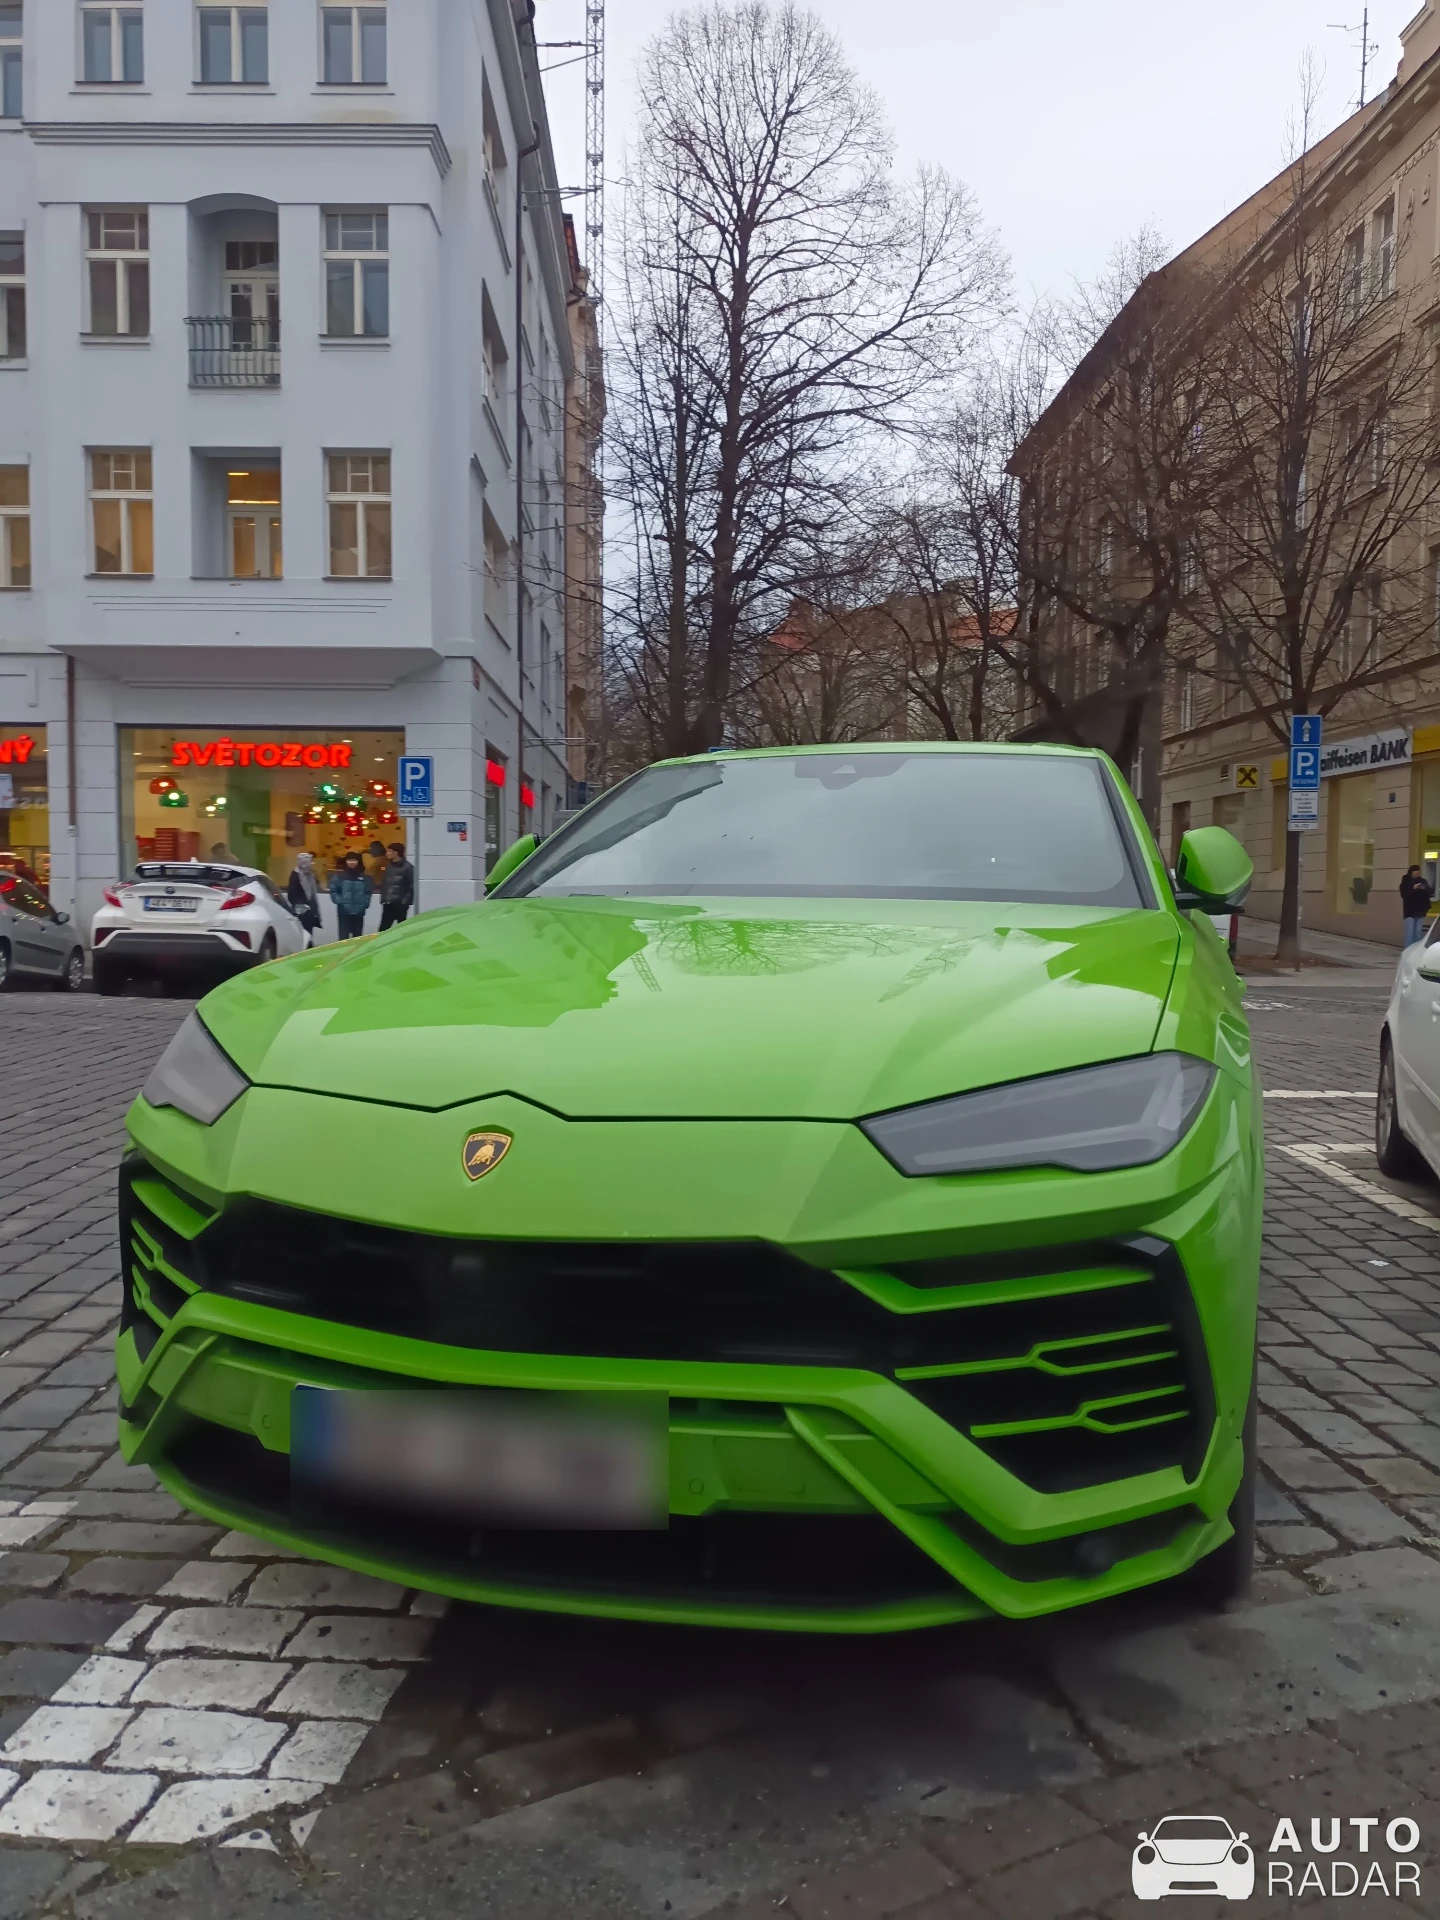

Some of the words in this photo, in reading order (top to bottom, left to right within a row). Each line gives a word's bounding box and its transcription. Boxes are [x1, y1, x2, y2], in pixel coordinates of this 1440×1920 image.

[171, 737, 352, 768] SVĚTOZOR
[1297, 752, 1315, 775] P
[1320, 748, 1367, 772] aiffeisen
[1370, 738, 1408, 763] BANK
[405, 763, 426, 790] P
